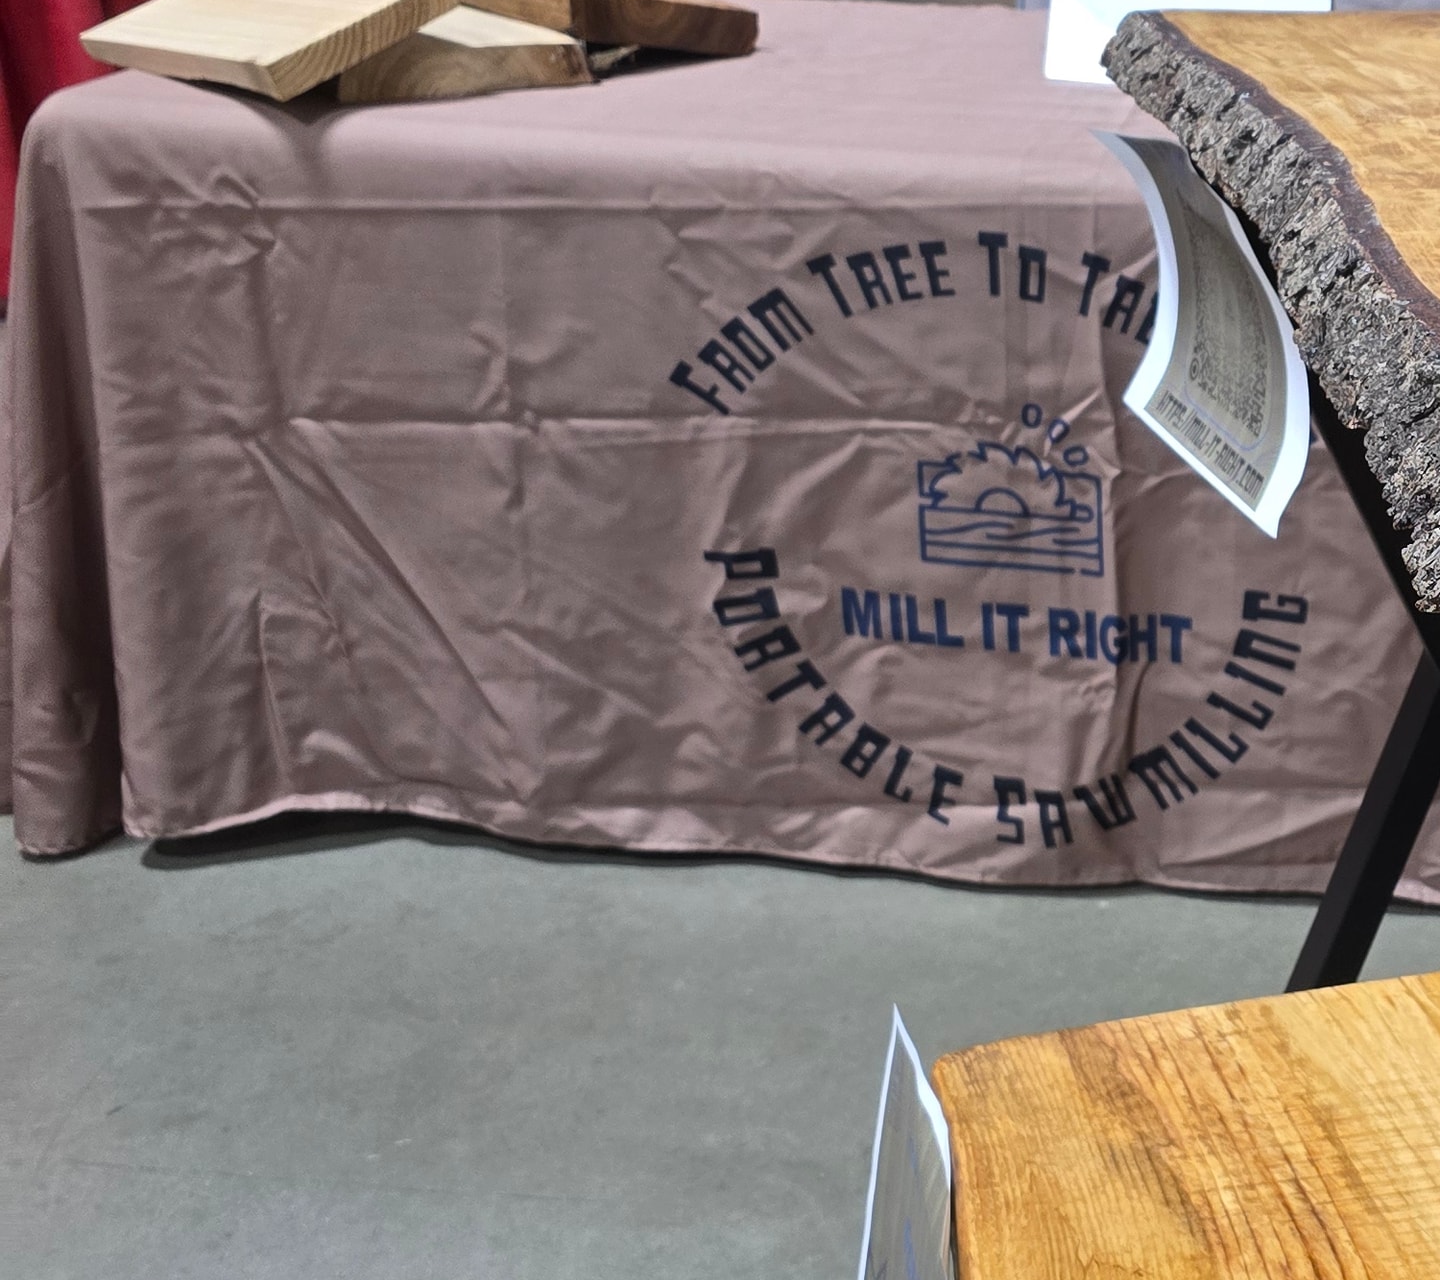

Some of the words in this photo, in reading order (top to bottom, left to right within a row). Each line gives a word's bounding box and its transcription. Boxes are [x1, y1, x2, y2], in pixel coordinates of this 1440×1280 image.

[669, 288, 814, 415] FROM
[806, 240, 955, 318] TREE
[979, 231, 1047, 303] TO
[703, 547, 964, 825] PORTABLE
[992, 589, 1309, 849] SAWMILLING
[840, 586, 965, 649] MILL
[981, 602, 1030, 655] IT
[1048, 607, 1193, 665] RIGHT
